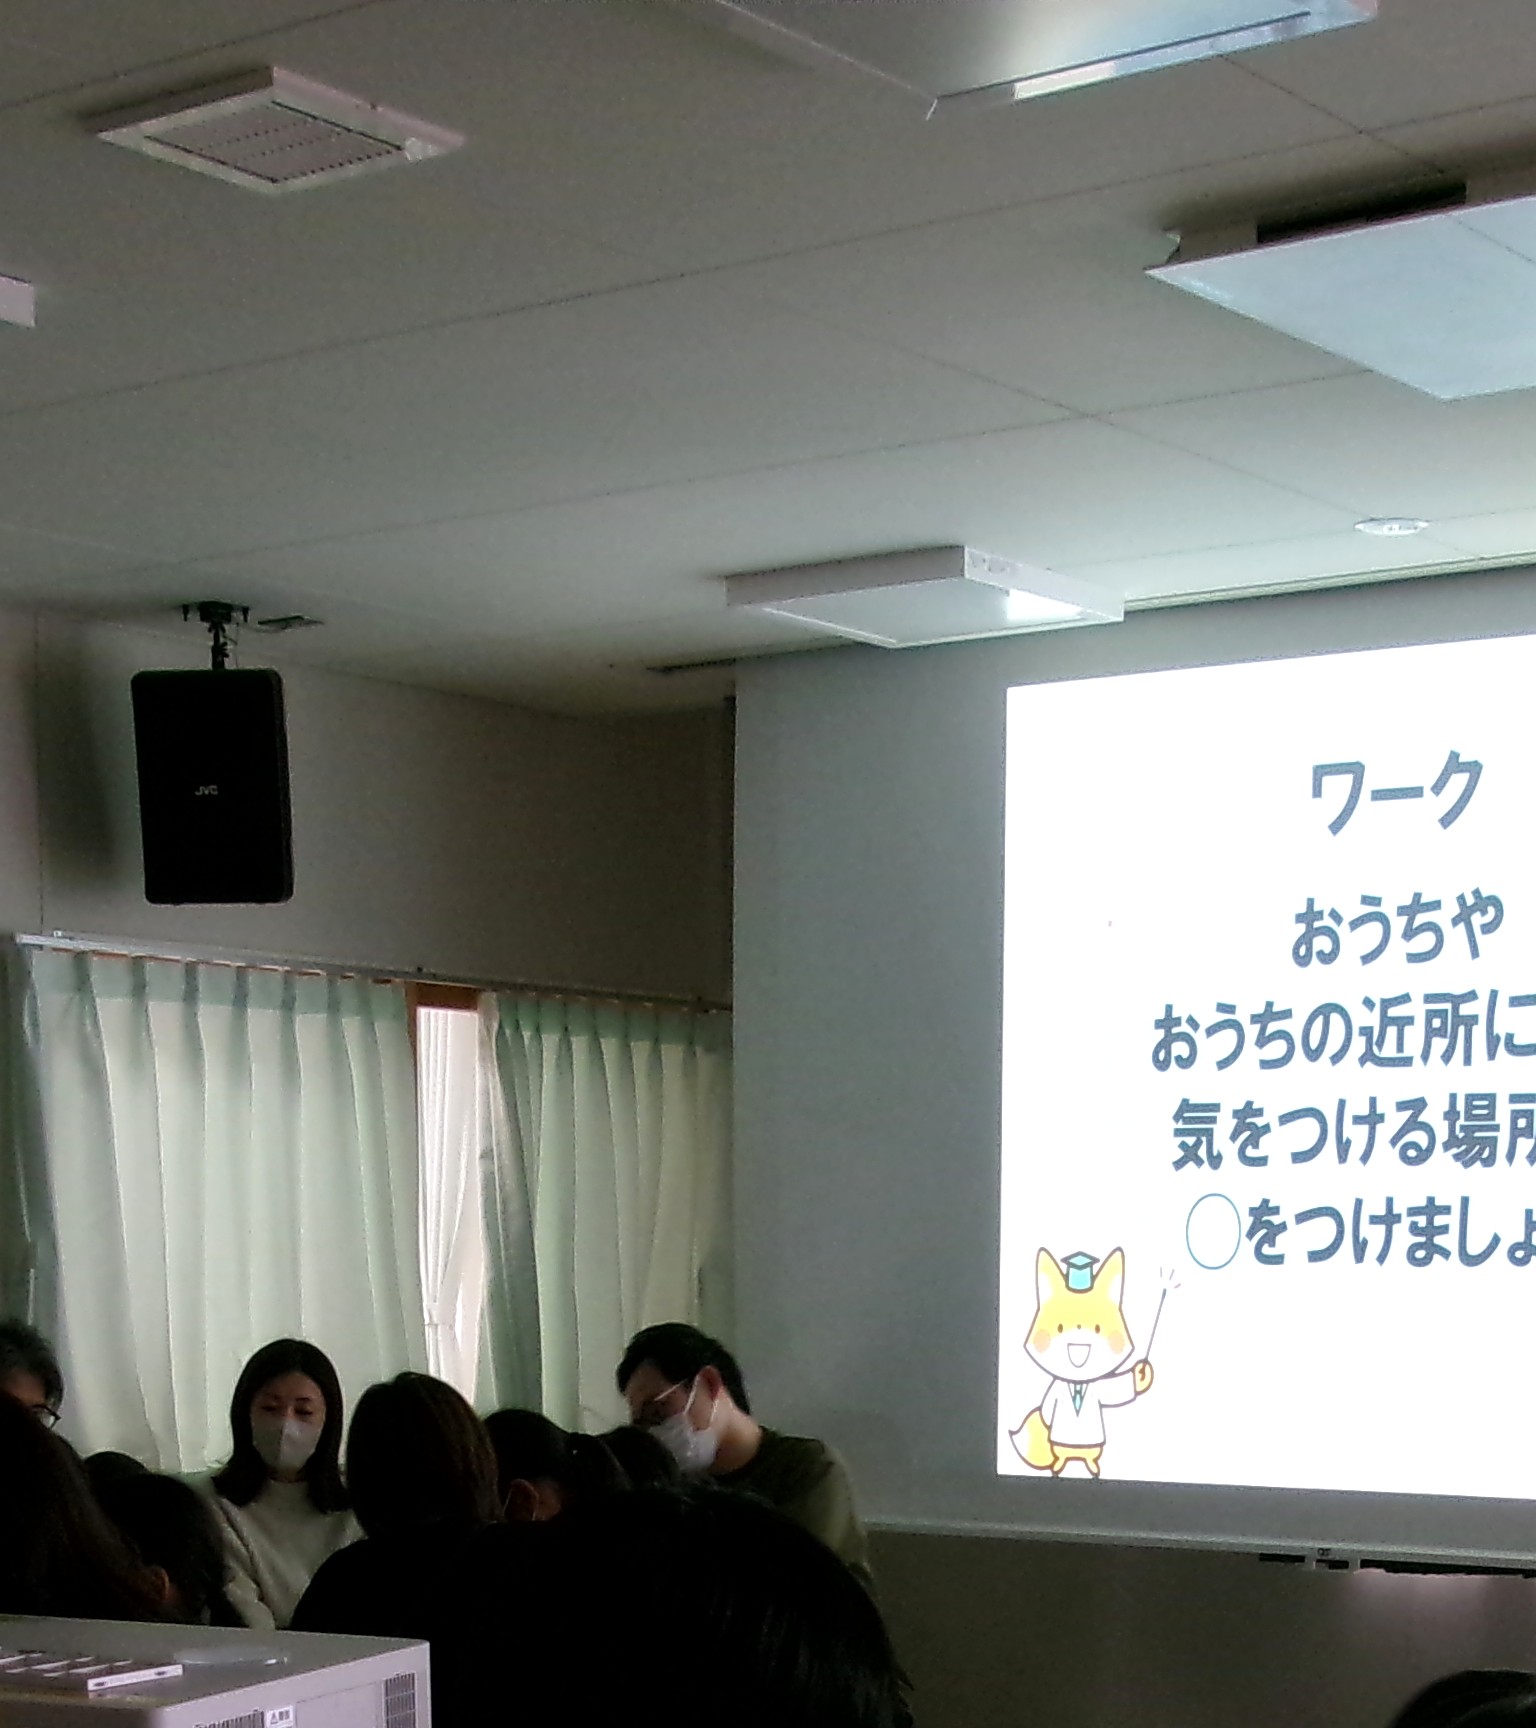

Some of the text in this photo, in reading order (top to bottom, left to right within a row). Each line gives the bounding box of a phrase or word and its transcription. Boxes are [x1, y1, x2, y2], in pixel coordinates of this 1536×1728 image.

[194, 784, 219, 797] JVC
[1311, 750, 1484, 836] ワーク
[1292, 887, 1505, 968] おうちや
